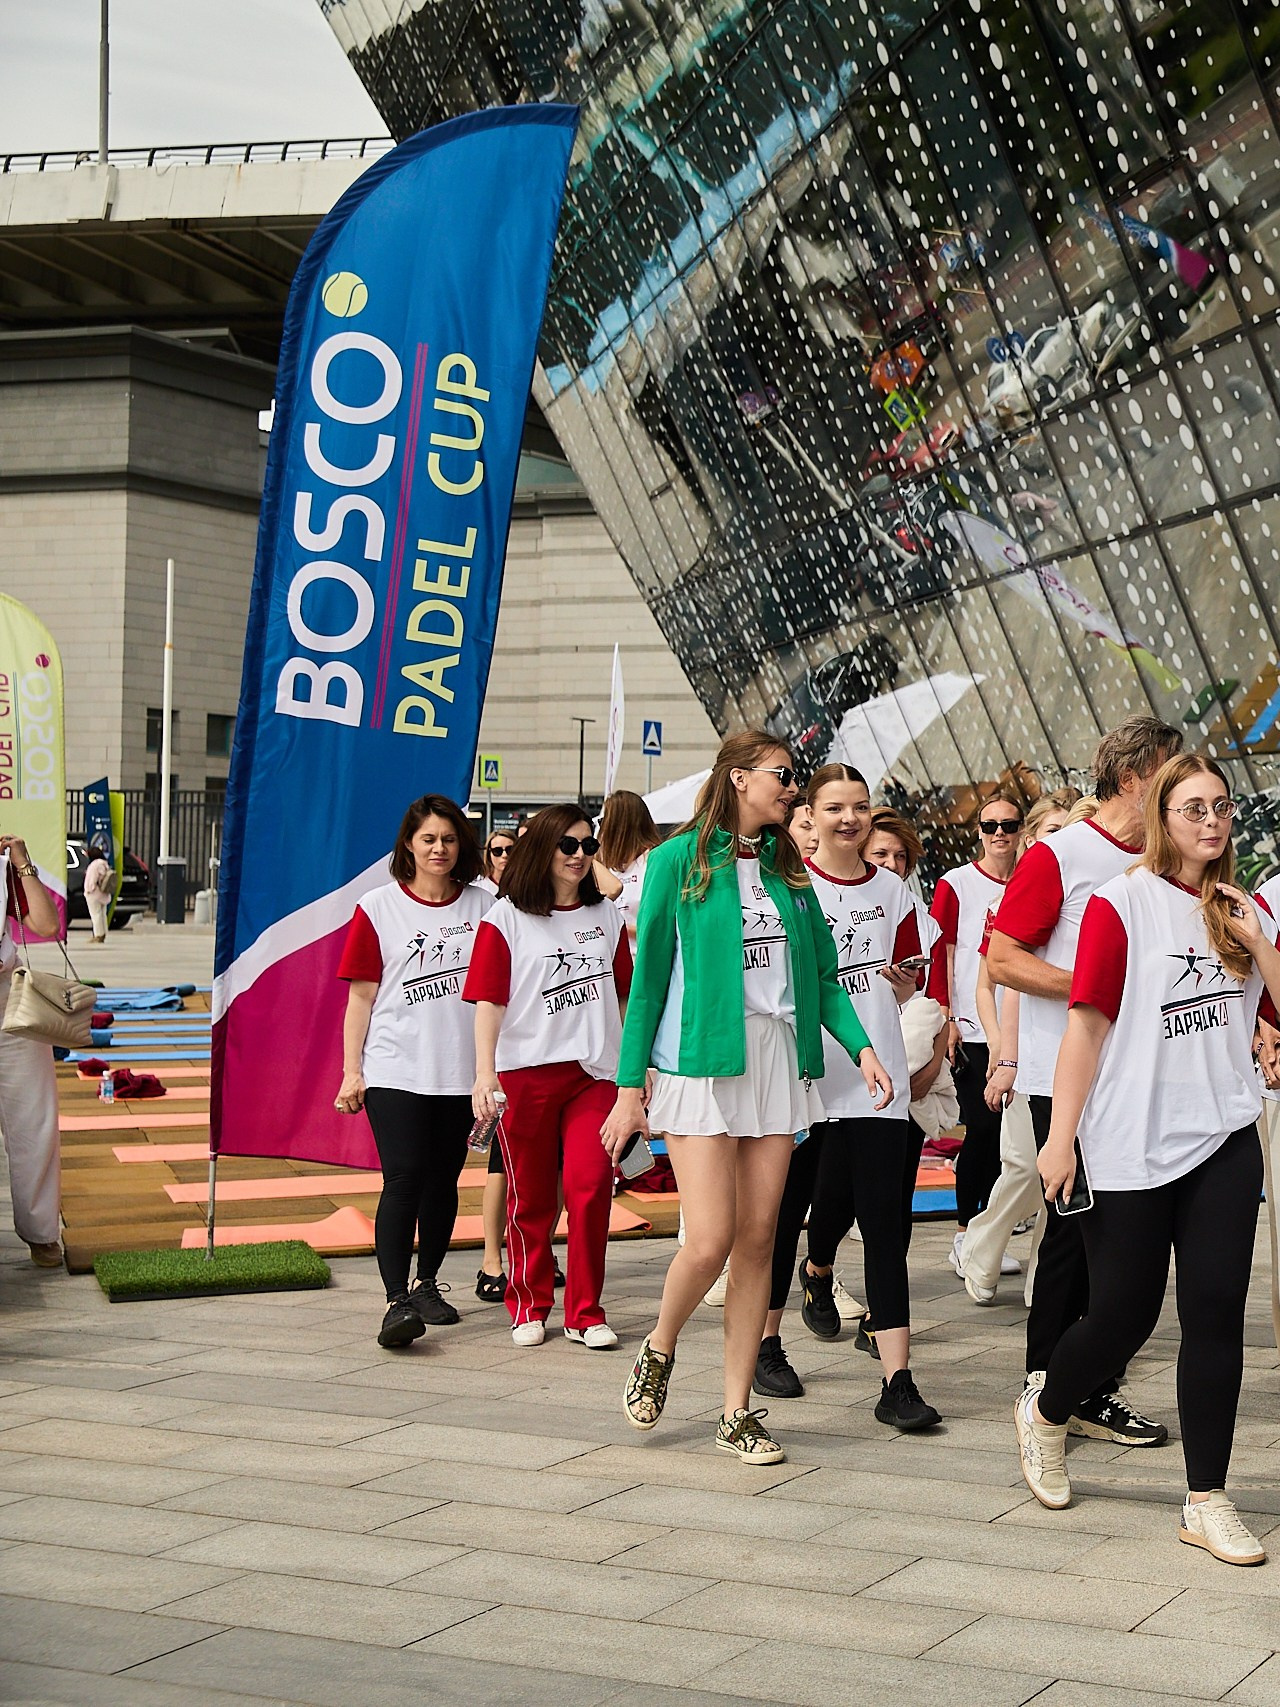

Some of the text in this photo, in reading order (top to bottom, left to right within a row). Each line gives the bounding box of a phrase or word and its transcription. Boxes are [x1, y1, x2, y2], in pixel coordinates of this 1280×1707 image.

[275, 332, 403, 727] BOSCO
[393, 352, 490, 739] PADEL CUP
[403, 976, 460, 1006] ЗАРЯДКА
[545, 983, 600, 1015] ЗАРЯДКА
[1163, 1002, 1229, 1039] ЗАРЯДКА
